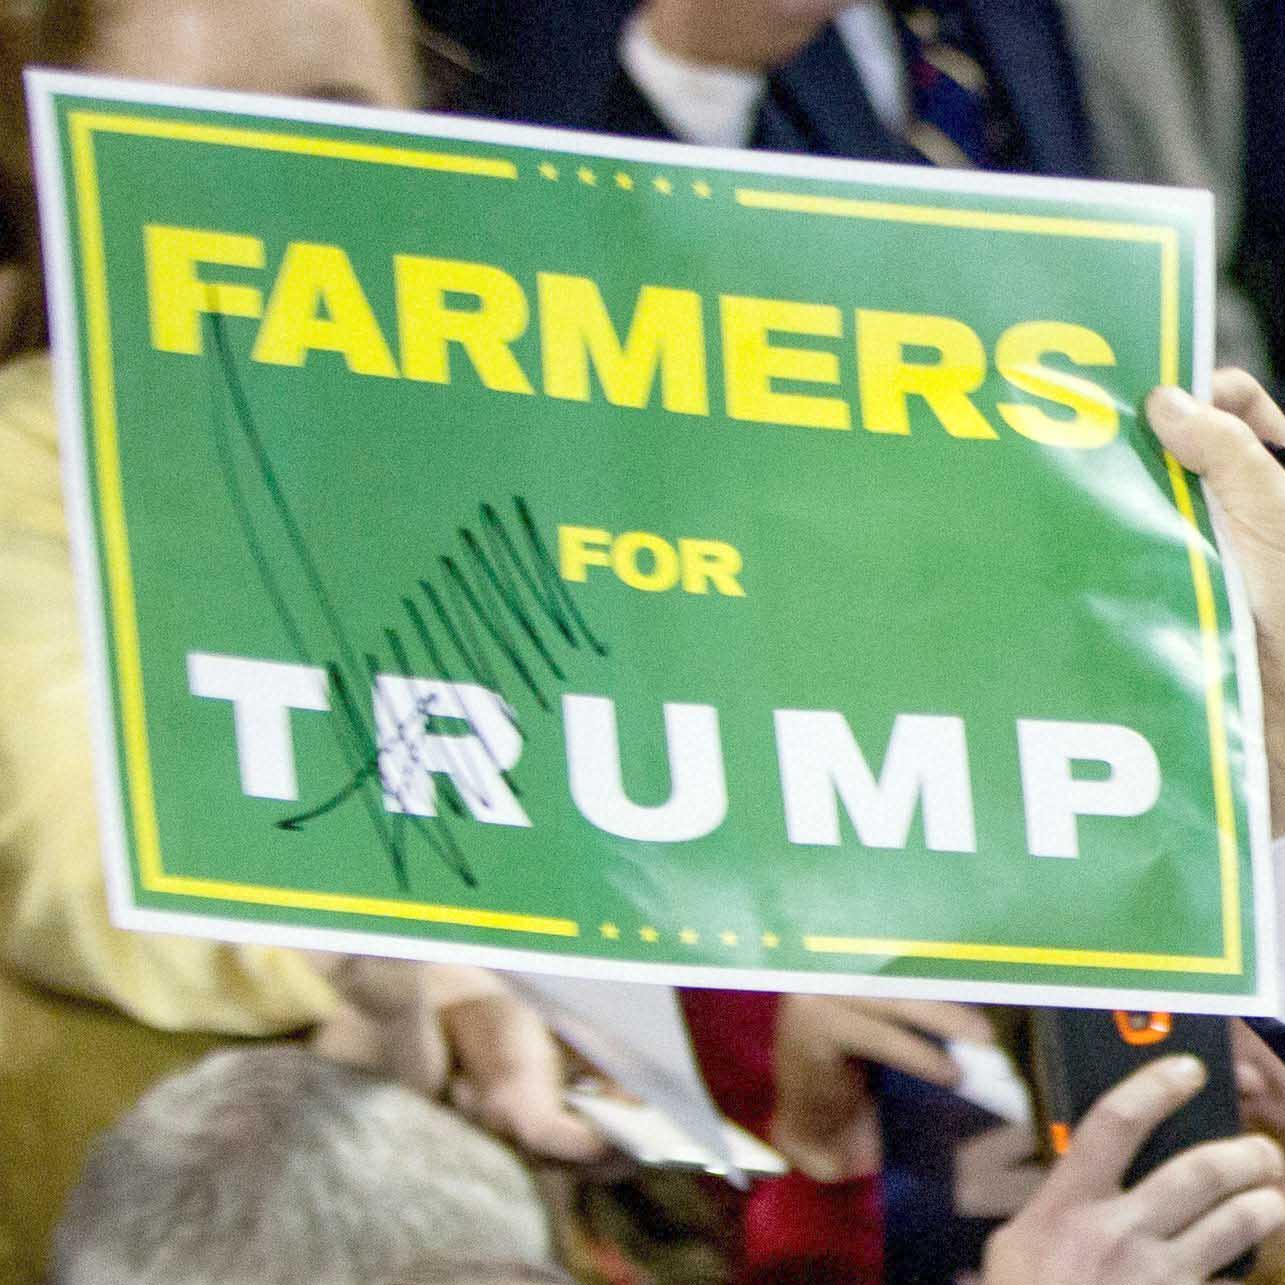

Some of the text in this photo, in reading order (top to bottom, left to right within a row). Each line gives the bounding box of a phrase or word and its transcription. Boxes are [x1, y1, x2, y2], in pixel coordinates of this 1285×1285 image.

[142, 223, 1121, 451] FARMERS
[558, 524, 746, 598] FOR
[186, 650, 1163, 860] TRUMP
